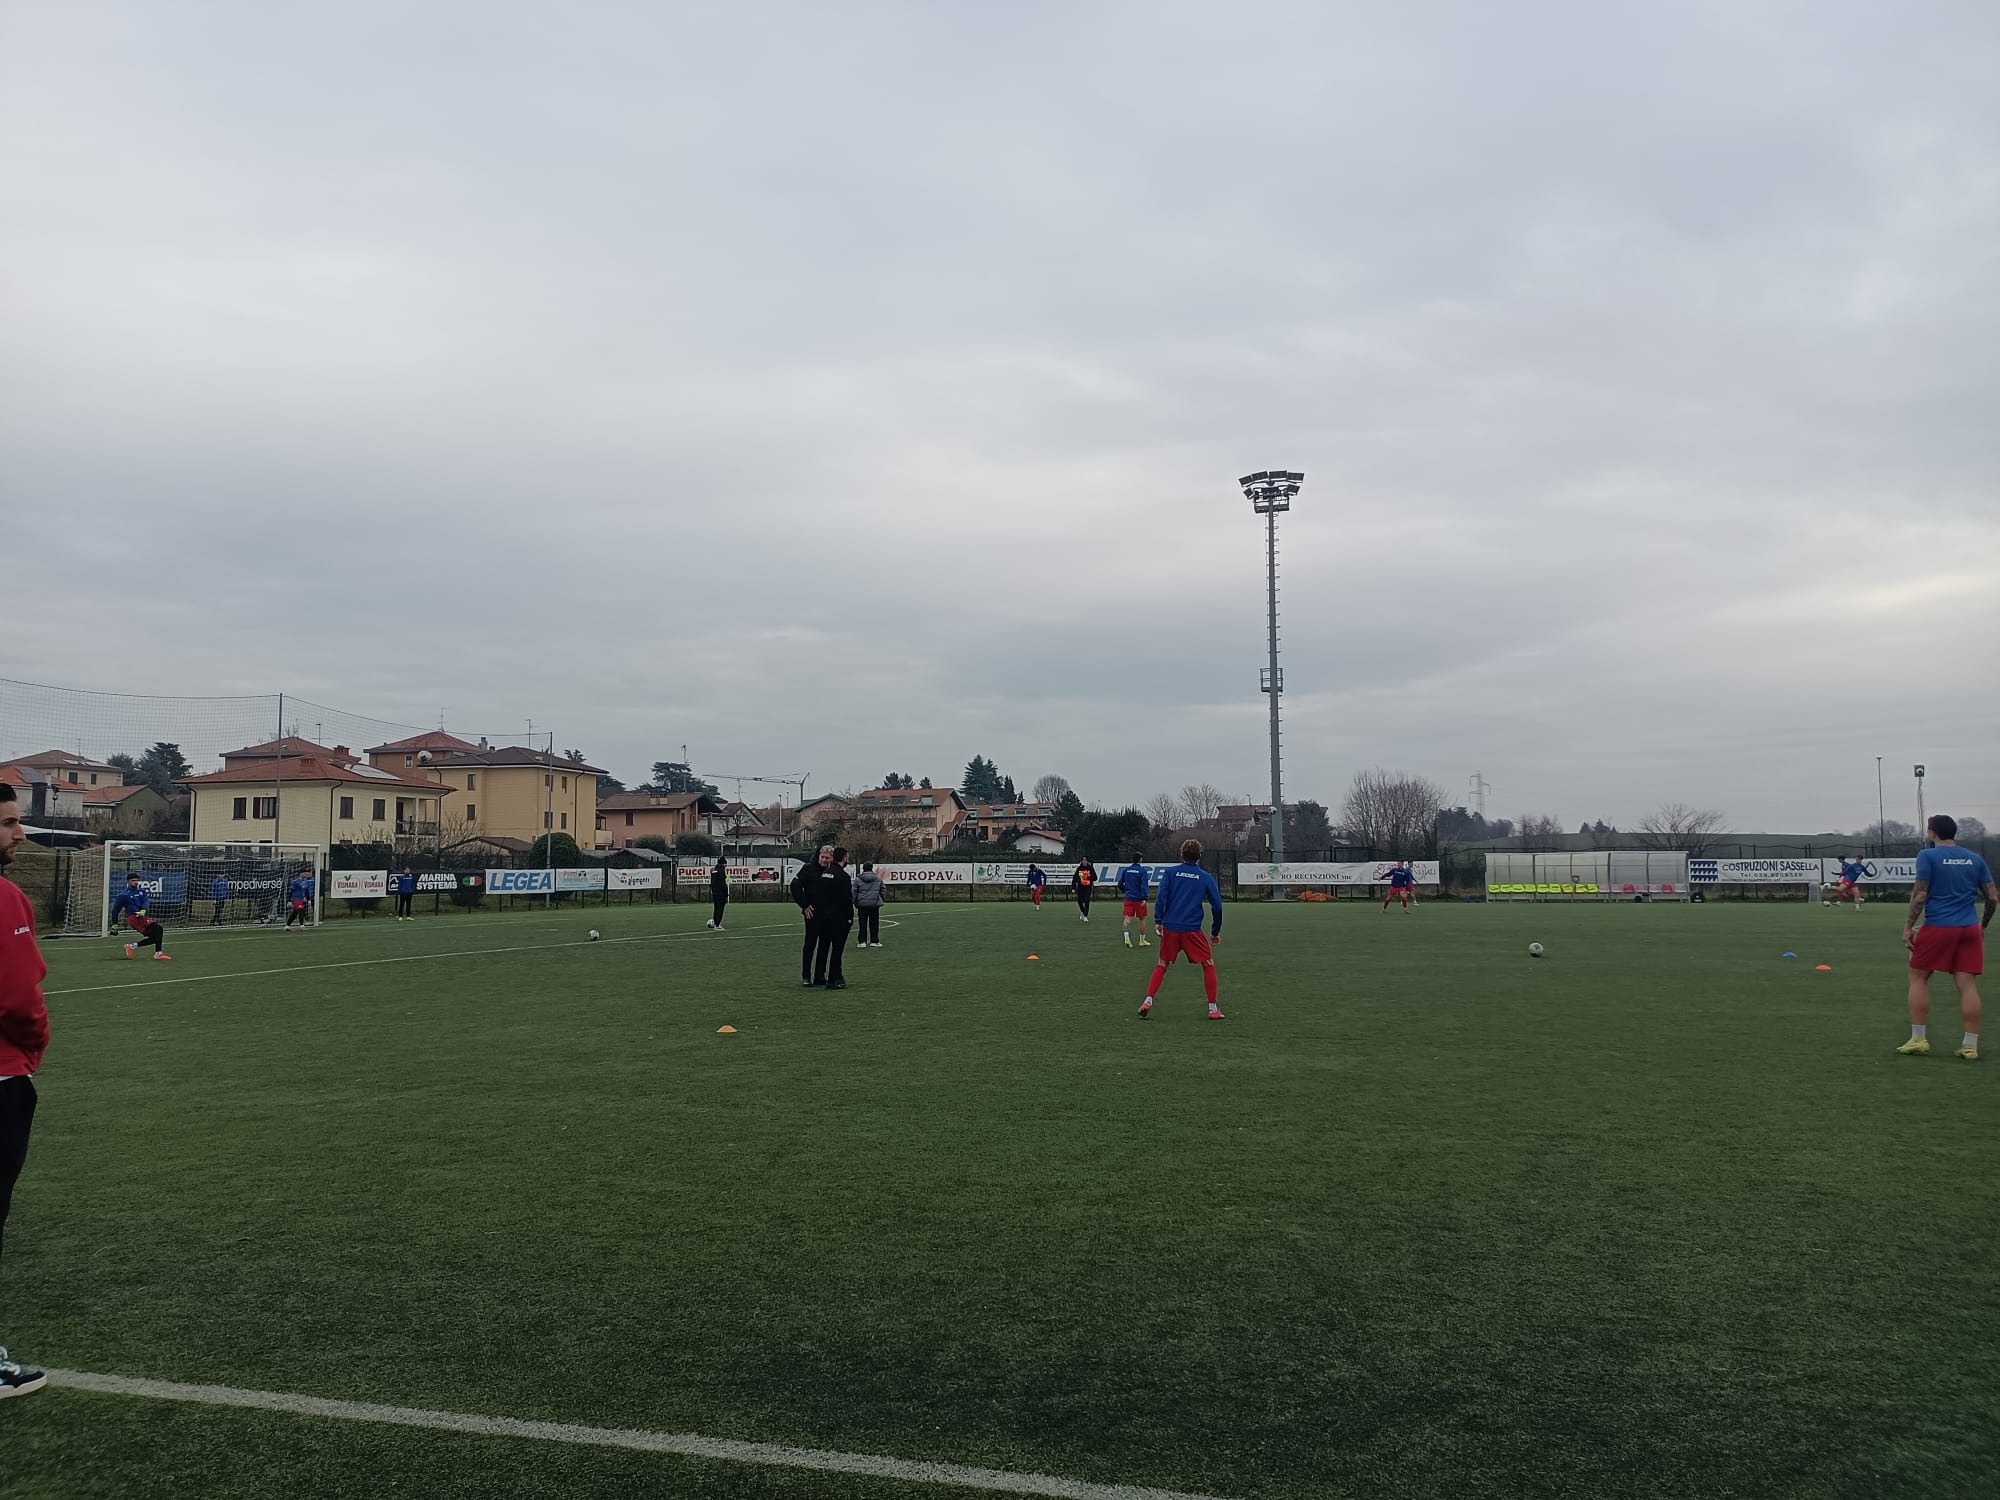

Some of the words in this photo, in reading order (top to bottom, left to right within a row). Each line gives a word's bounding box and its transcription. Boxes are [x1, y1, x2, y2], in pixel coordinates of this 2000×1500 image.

[1722, 861, 1778, 872] COSTRUZIONI
[1780, 861, 1819, 871] SASSELLA
[1884, 866, 1916, 876] VILL
[679, 868, 706, 876] Pucci
[890, 871, 964, 881] EUROPAV.it
[227, 878, 282, 891] mpediverse
[416, 882, 458, 890] SYSTEMS
[489, 873, 552, 891] LEGEA
